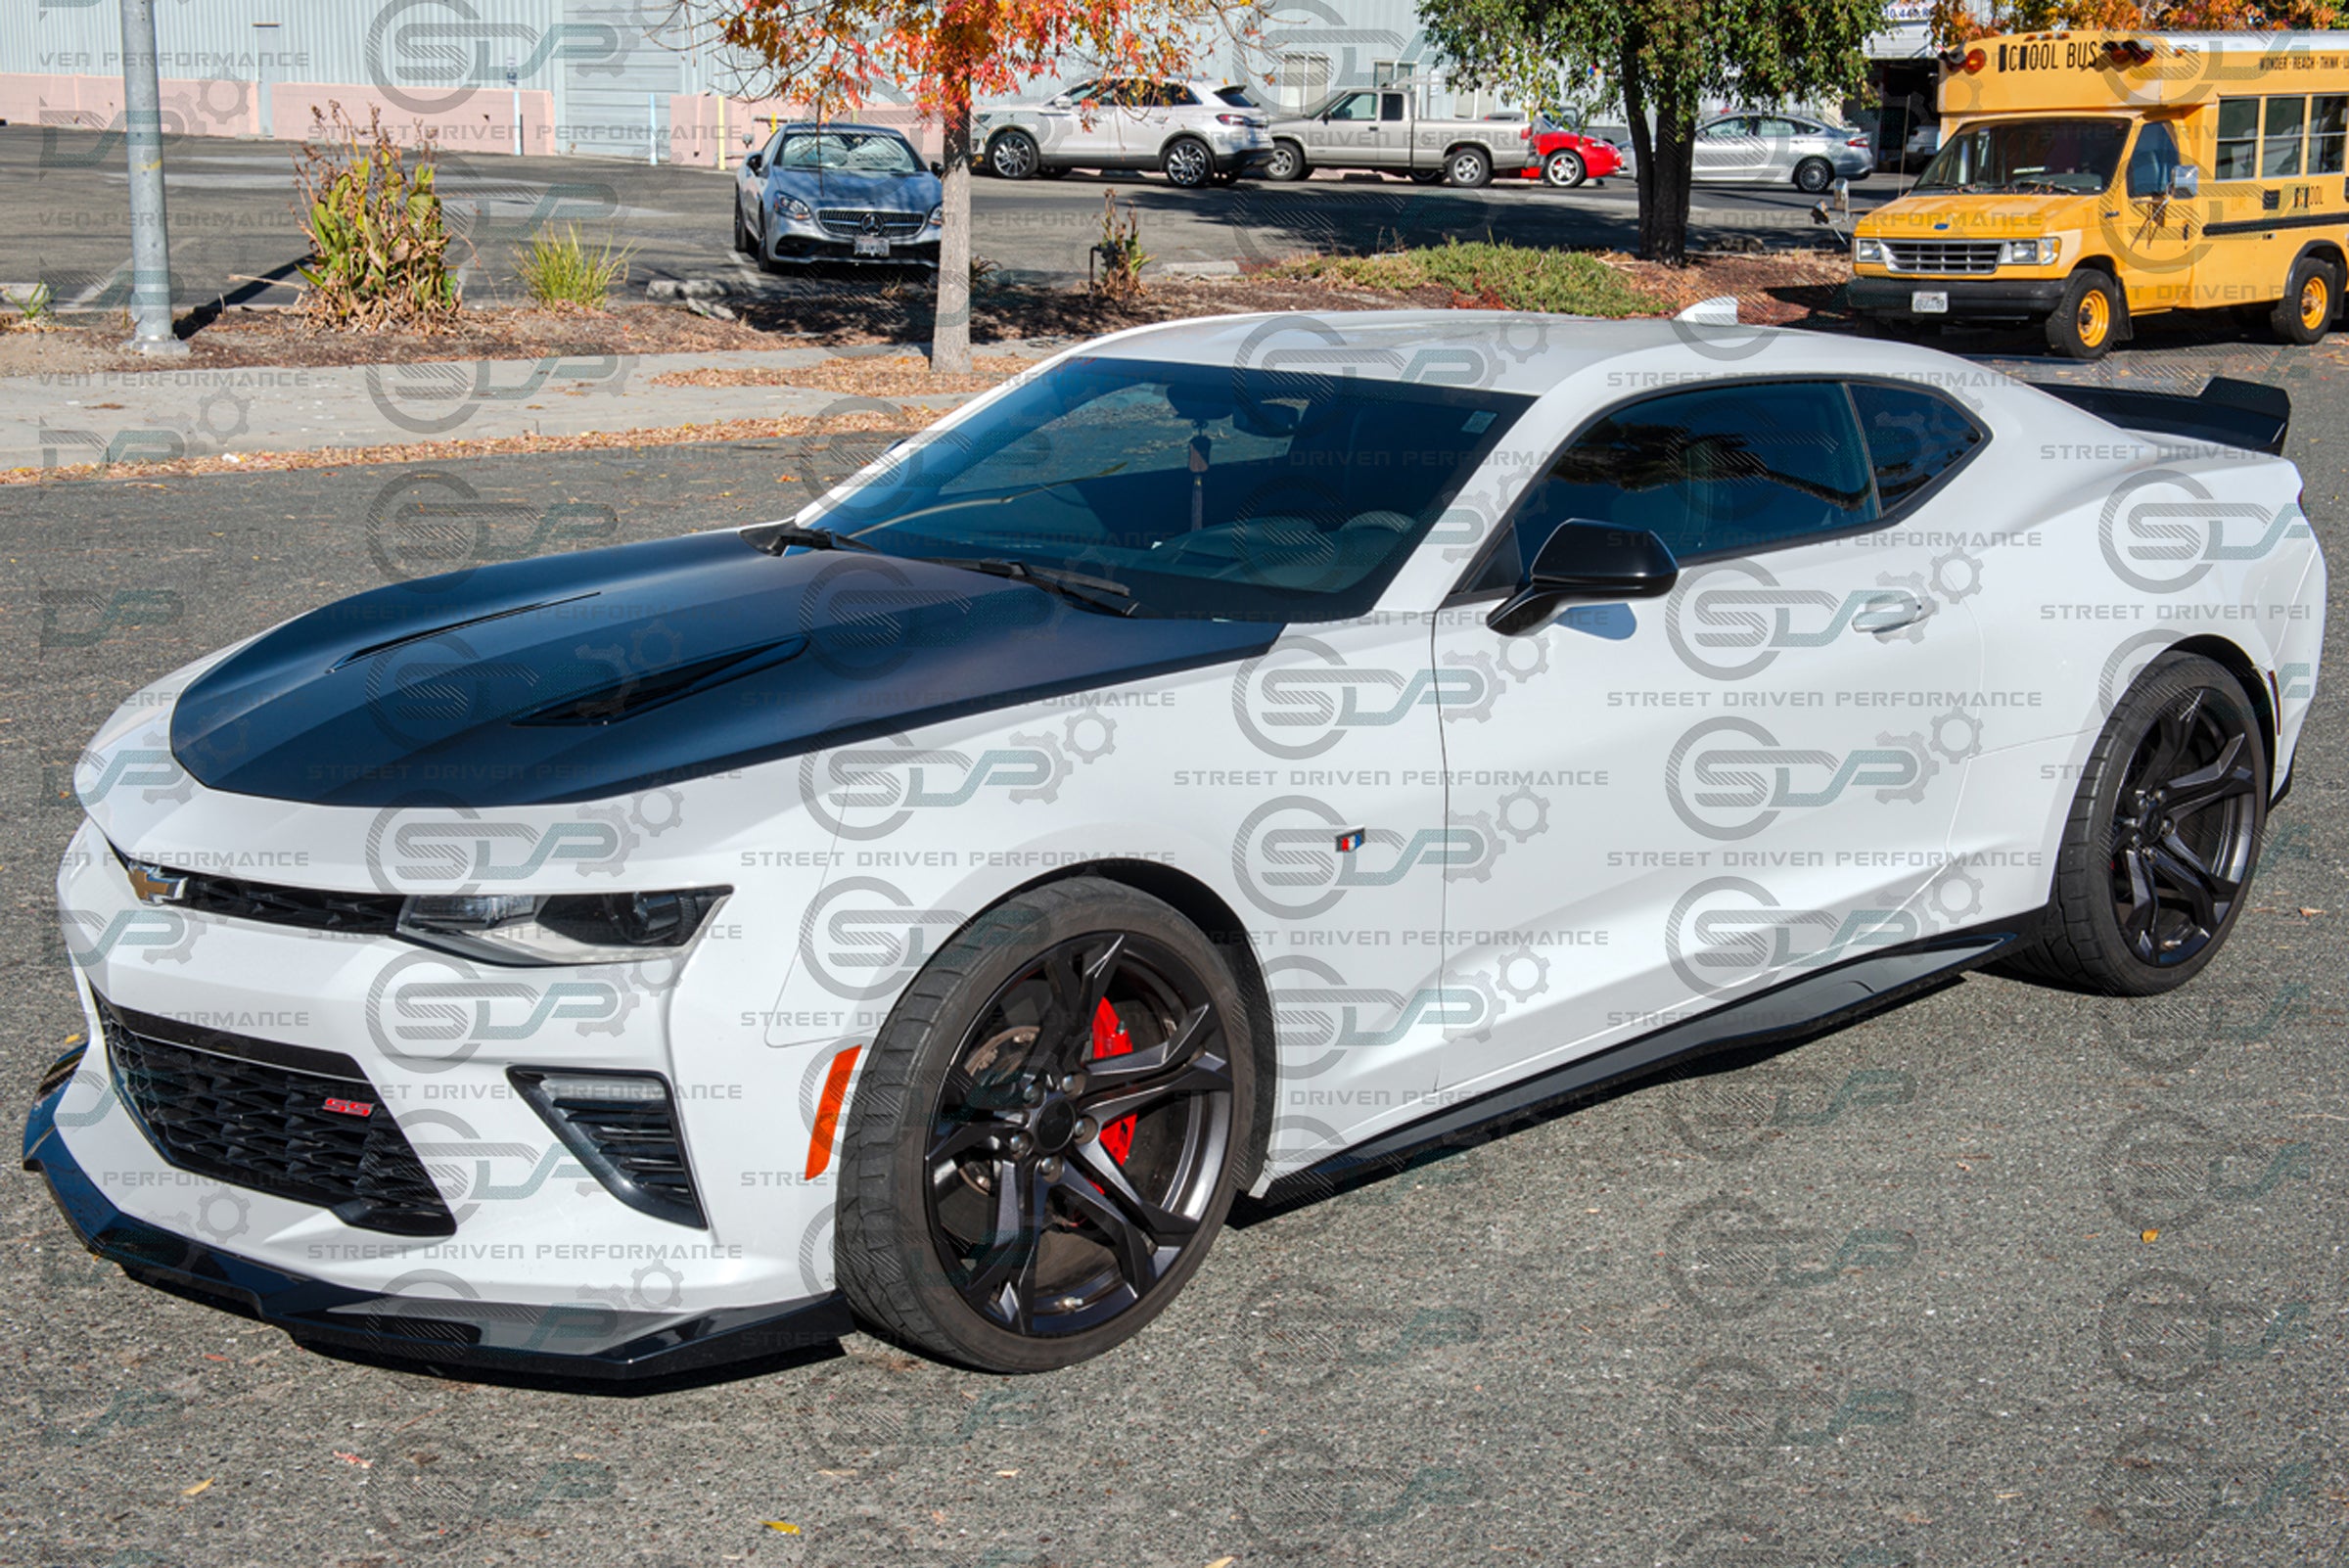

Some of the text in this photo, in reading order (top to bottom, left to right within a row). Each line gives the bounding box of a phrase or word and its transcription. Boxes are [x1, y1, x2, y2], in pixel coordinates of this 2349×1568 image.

[1999, 43, 2058, 72] COOL
[2066, 41, 2097, 69] BUS
[322, 1097, 375, 1117] SS
